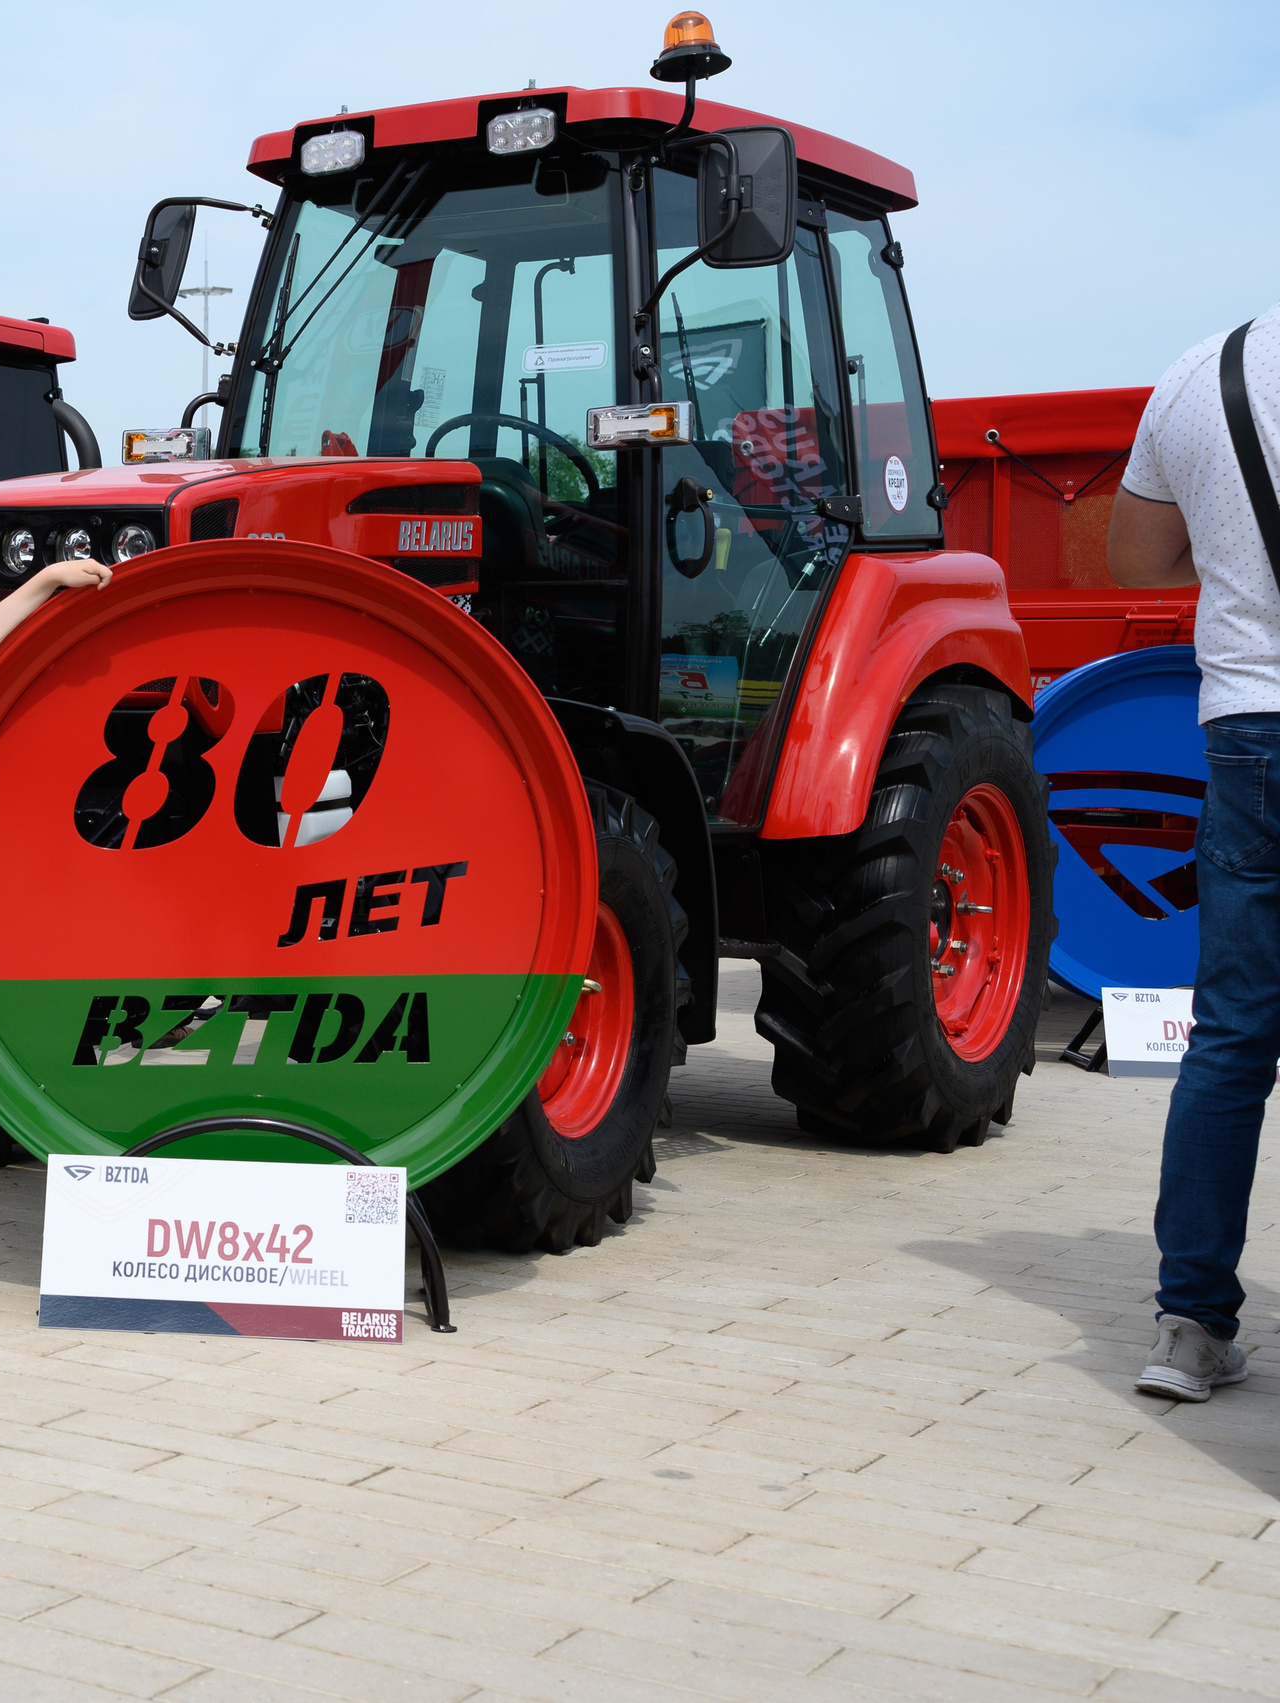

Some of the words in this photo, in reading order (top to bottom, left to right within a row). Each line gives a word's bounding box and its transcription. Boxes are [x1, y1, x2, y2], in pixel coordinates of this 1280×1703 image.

[397, 520, 474, 551] BELARUS
[73, 671, 391, 850] 80
[276, 860, 469, 948] ЛЕТ
[1135, 993, 1161, 1003] BZTDA
[71, 991, 431, 1066] BZTDA
[1146, 1042, 1185, 1052] КОЛЕСО
[104, 1165, 150, 1184] BZTDA
[146, 1218, 314, 1265] DW8x42
[112, 1260, 180, 1280] КОЛЕСО
[341, 1311, 397, 1327] BELARUS
[341, 1324, 397, 1339] TRACTORS
